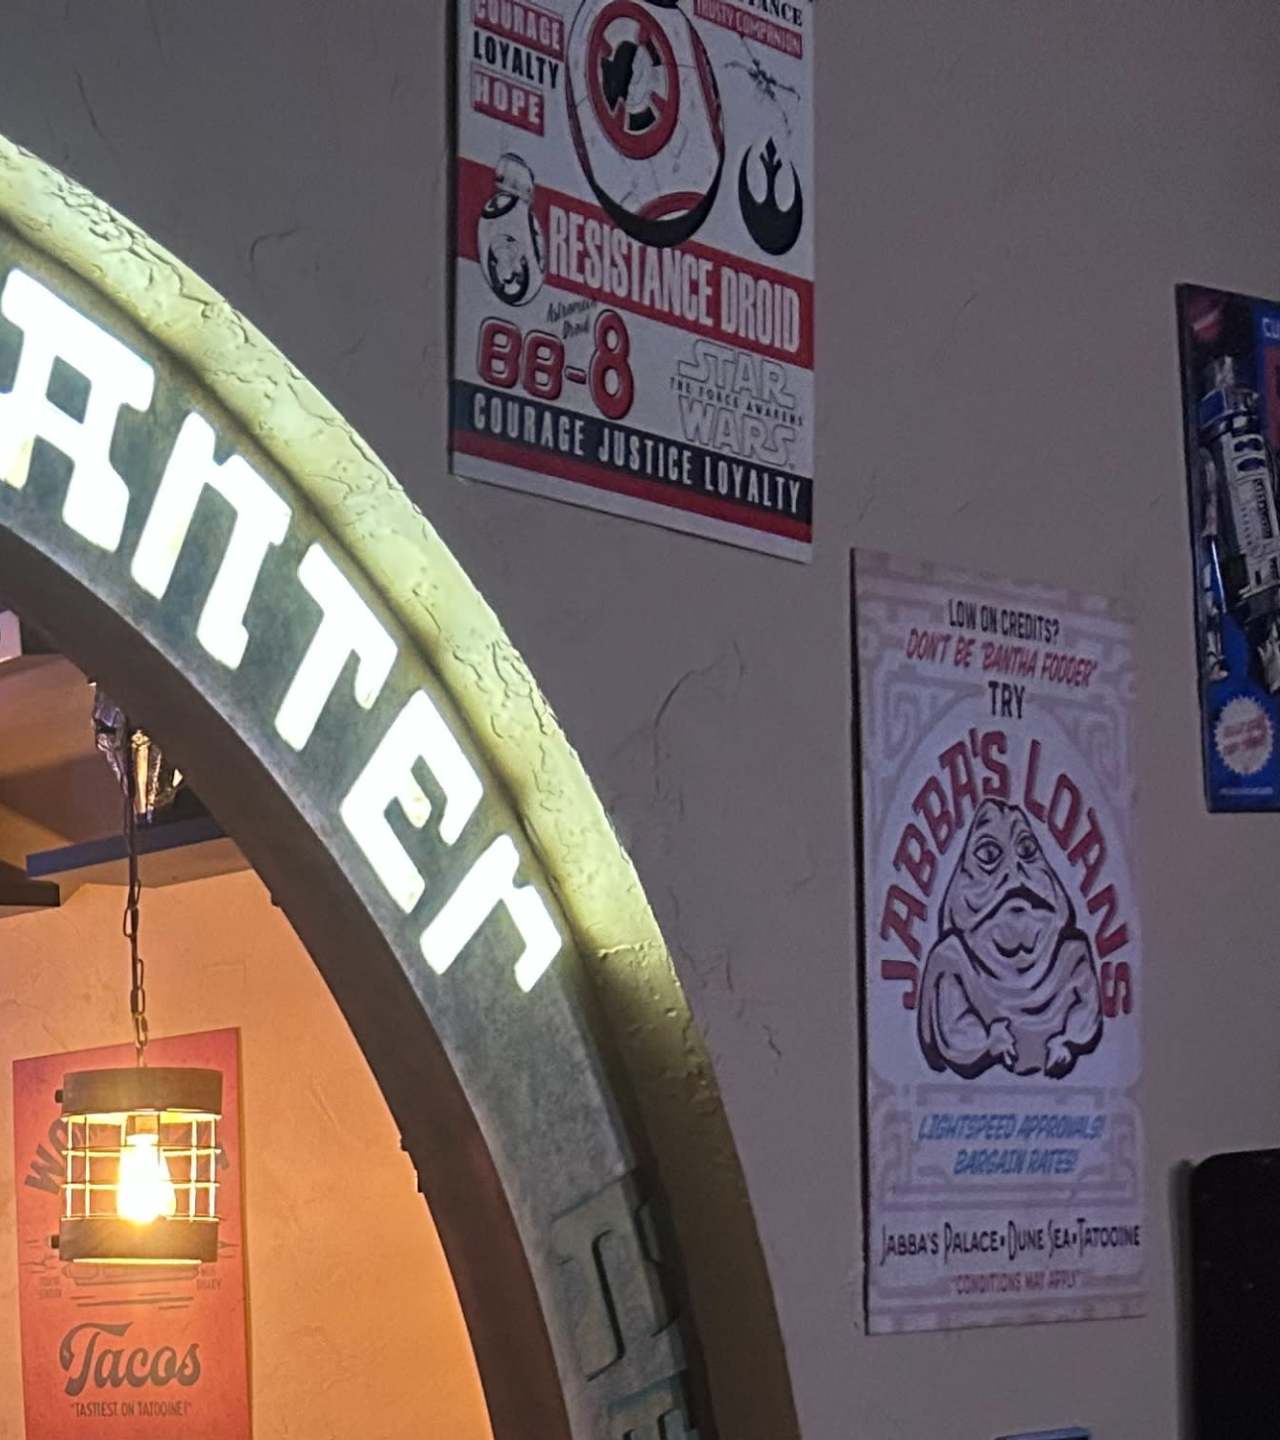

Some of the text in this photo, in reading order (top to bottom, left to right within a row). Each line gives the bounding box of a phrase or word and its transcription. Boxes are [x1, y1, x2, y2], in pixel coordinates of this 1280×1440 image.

[473, 30, 559, 90] LOYALTY
[474, 72, 541, 124] HOPE
[549, 204, 801, 354] RESISTANCE DROID
[670, 377, 691, 394] THE
[699, 386, 739, 409] FORCE
[678, 339, 796, 410] STAR
[473, 392, 802, 514] COURAGE JUSTICE LOYALTY
[678, 393, 797, 467] WARS
[906, 627, 952, 664] DON'T
[954, 636, 976, 669] BE
[949, 599, 1060, 645] LOW ON CREDITS?
[988, 680, 1026, 720] TRY
[879, 726, 1133, 1019] JABBA'S LOANS
[59, 1321, 201, 1397] Tacos
[121, 1402, 135, 1416] ON
